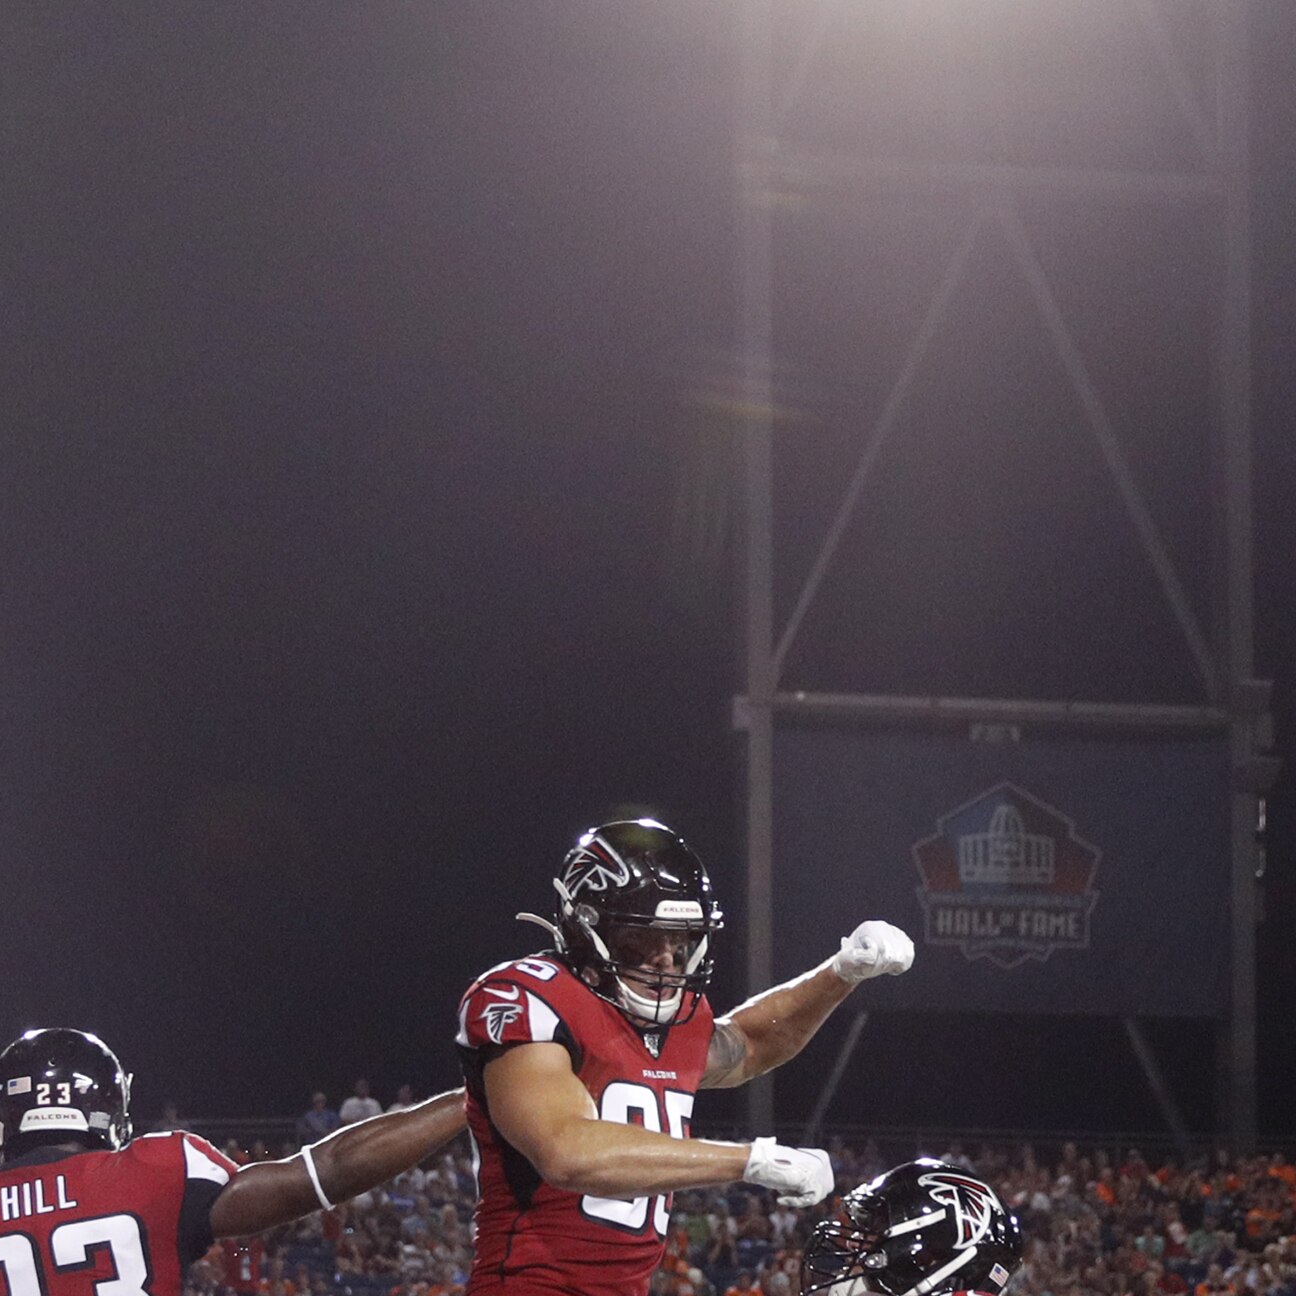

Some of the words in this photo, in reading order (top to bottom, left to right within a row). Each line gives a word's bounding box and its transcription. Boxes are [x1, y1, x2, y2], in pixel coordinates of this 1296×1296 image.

[937, 907, 1001, 937] HALL
[1019, 907, 1080, 940] FAME
[642, 1069, 678, 1081] FALCONS
[36, 1082, 71, 1105] 23
[27, 1113, 78, 1121] FALCONS
[0, 1174, 78, 1222] HILL
